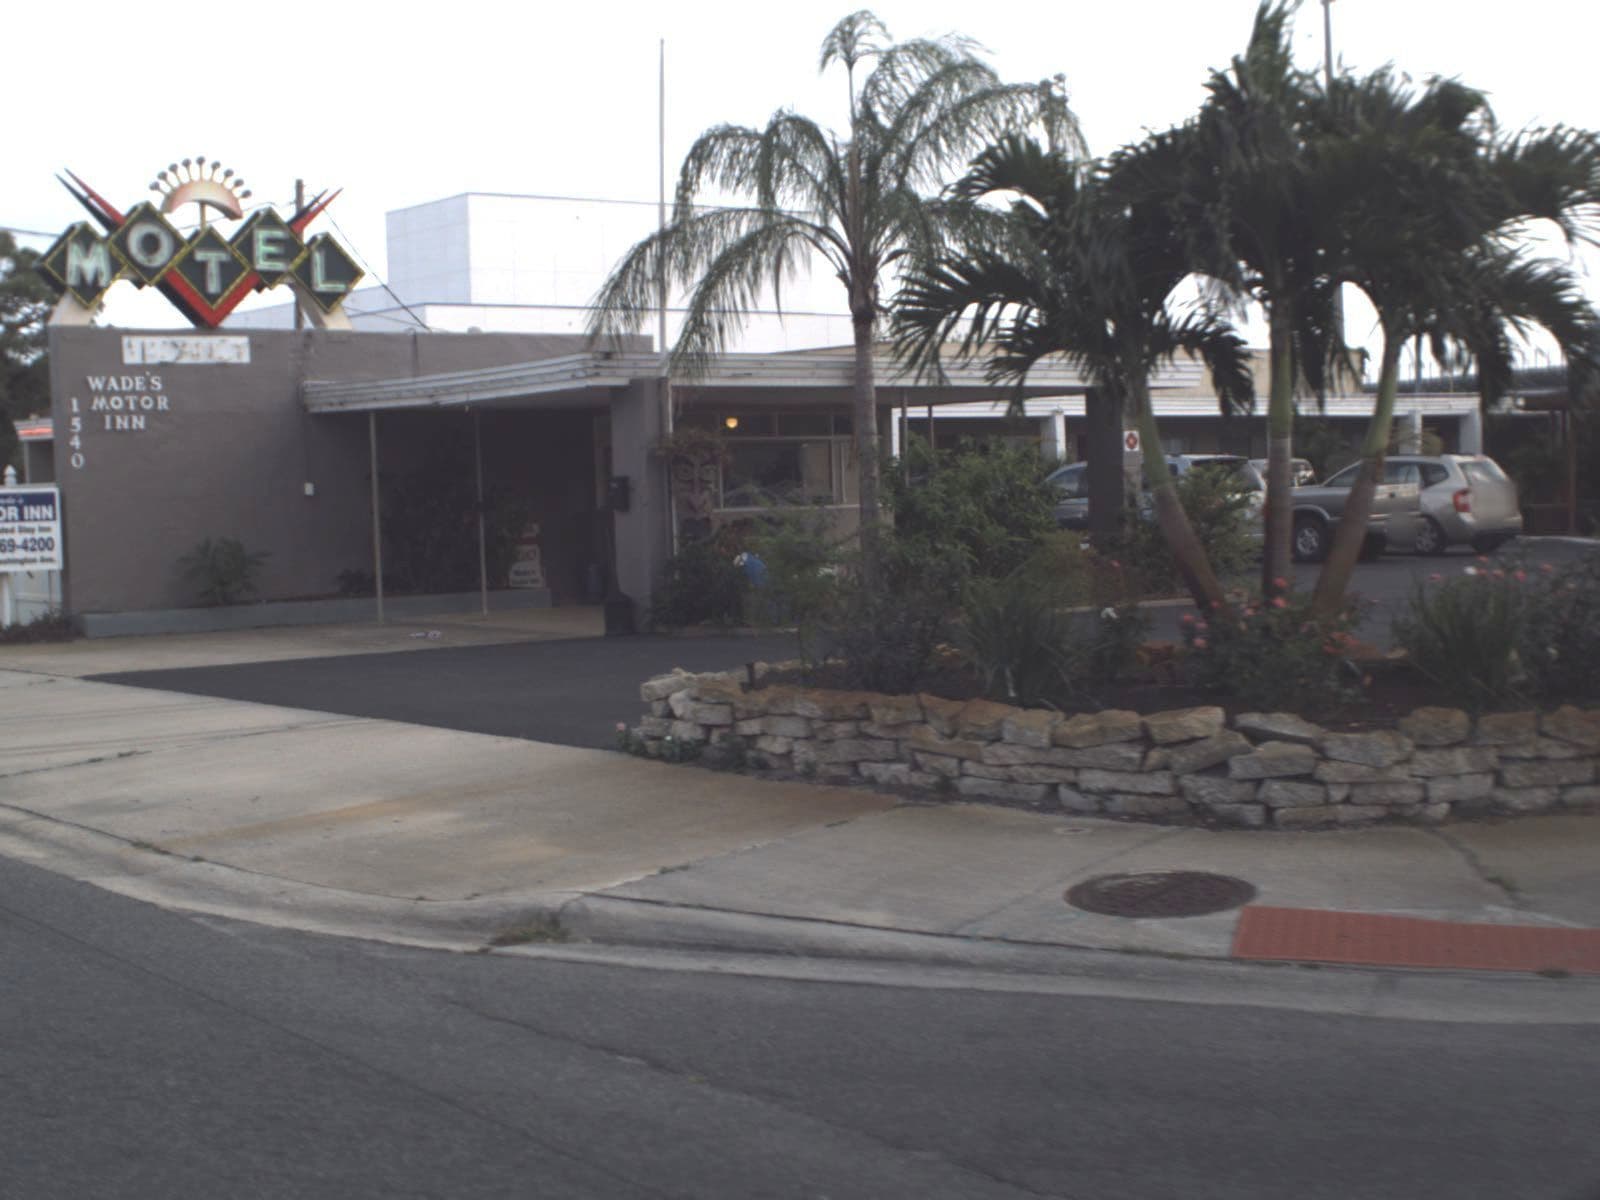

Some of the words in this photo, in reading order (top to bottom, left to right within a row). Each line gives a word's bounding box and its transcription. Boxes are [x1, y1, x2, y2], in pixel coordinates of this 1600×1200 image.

[66, 221, 346, 294] MOTEL
[86, 371, 162, 391] WADE'S
[91, 395, 169, 411] MOTOR
[103, 414, 146, 431] INN
[69, 397, 85, 469] 1540
[23, 504, 54, 521] INN
